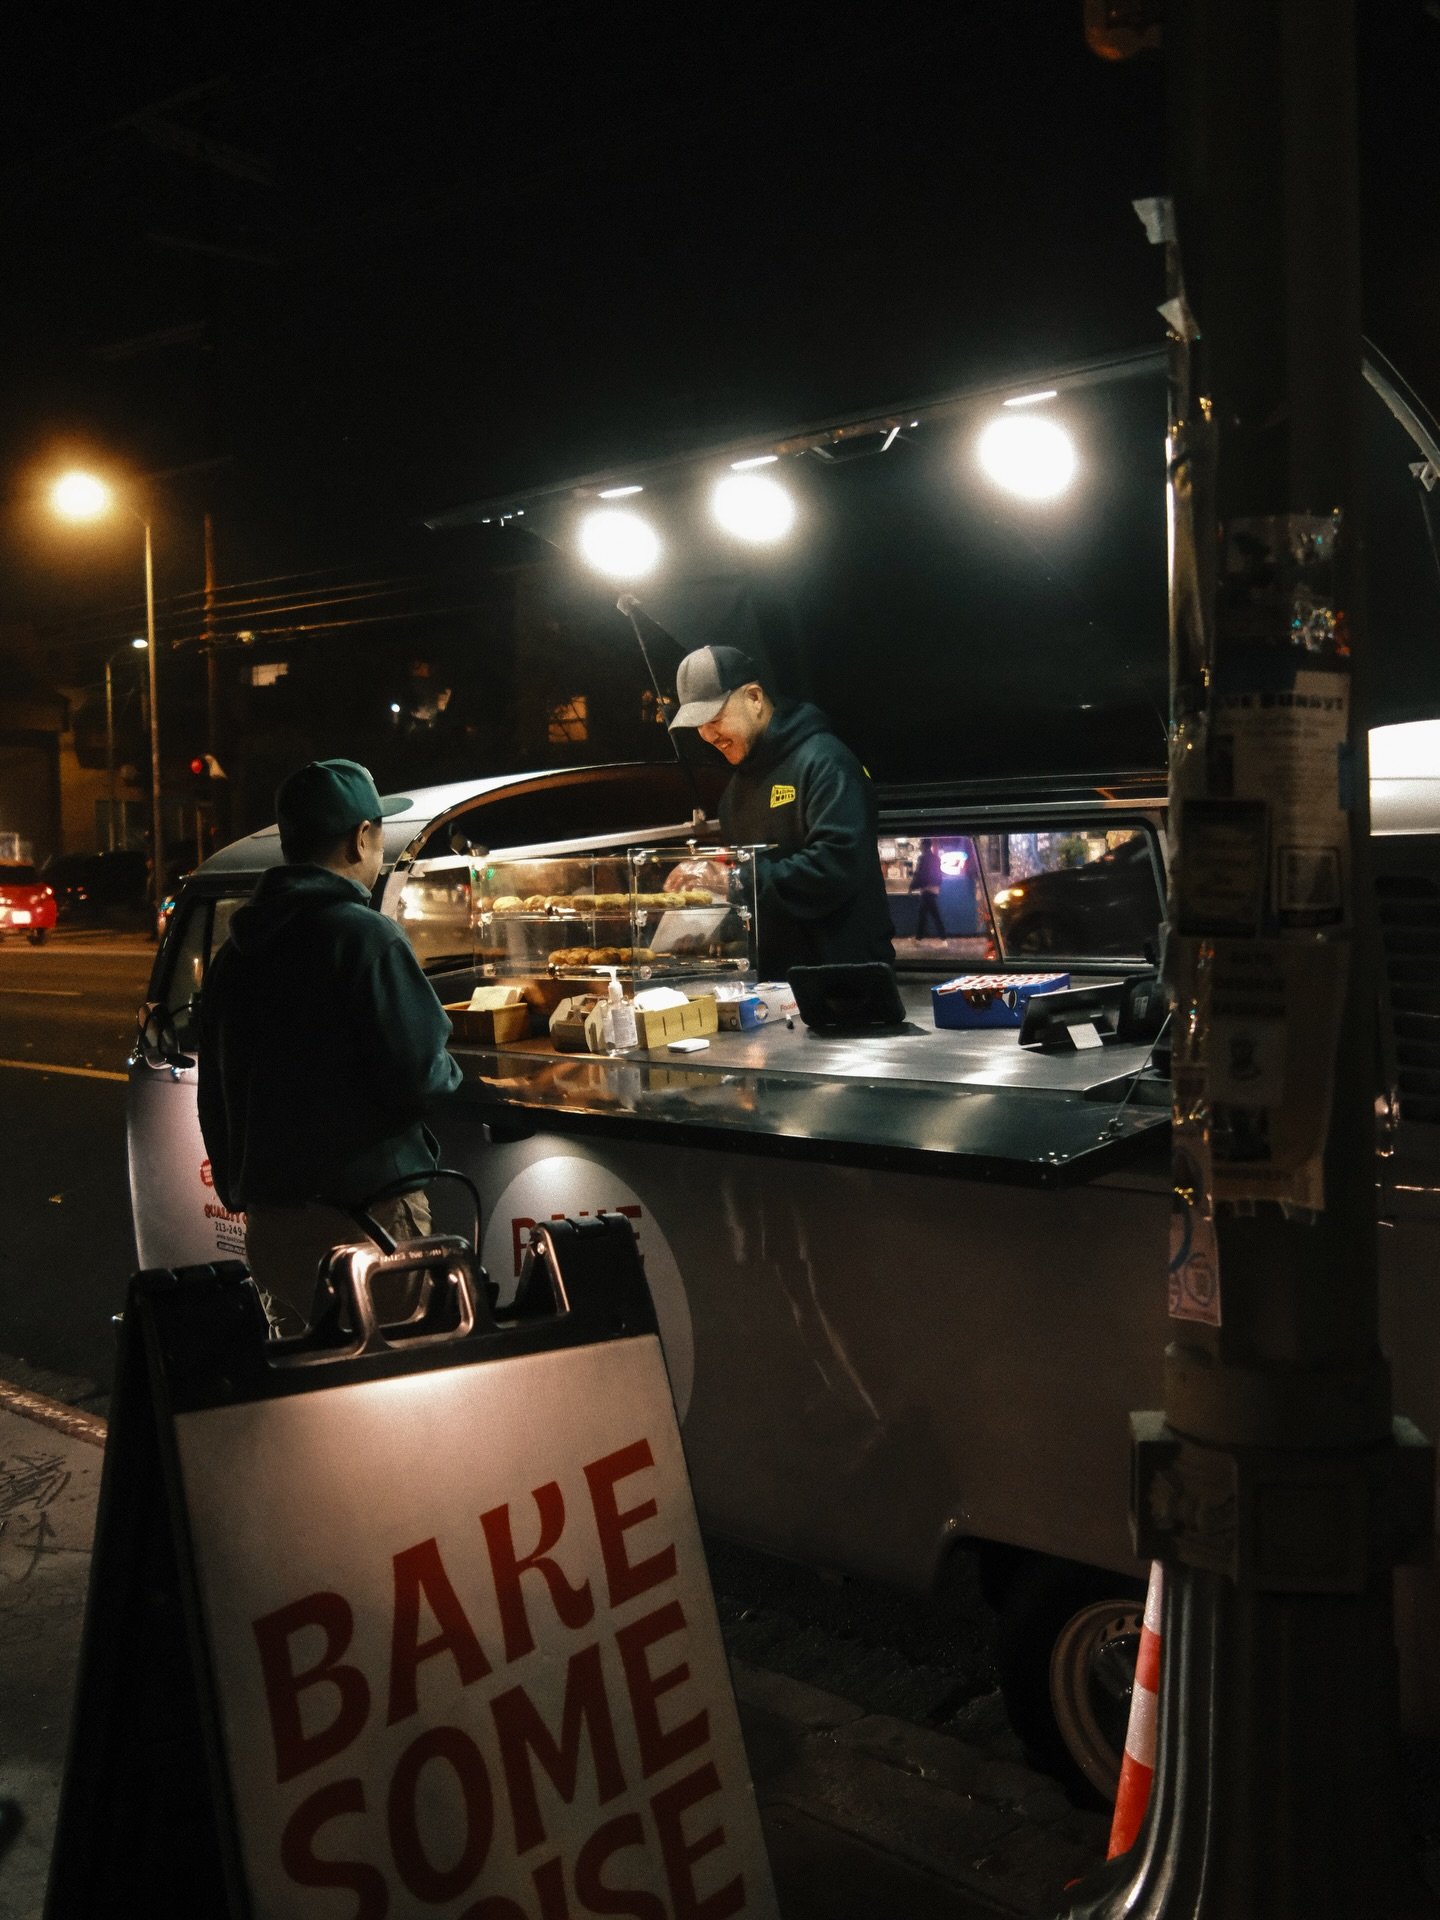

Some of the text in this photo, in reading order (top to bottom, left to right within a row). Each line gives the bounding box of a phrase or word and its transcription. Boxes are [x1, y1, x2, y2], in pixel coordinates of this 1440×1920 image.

[215, 1221, 247, 1236] 213-249-
[252, 1438, 678, 1785] BAKE
[280, 1600, 711, 1920] SOME
